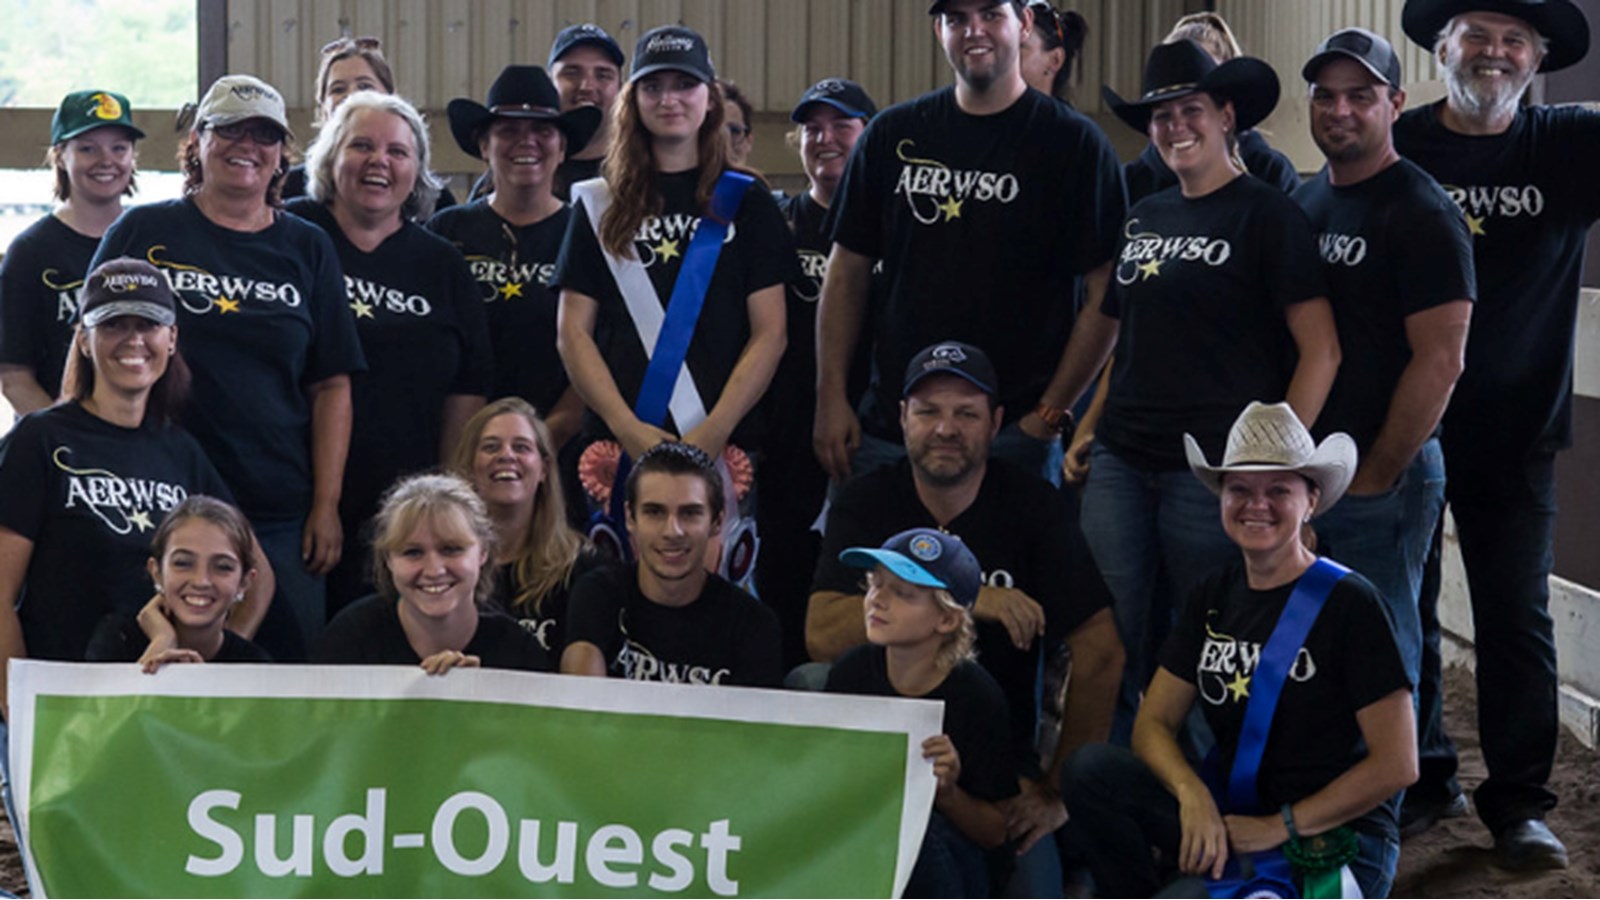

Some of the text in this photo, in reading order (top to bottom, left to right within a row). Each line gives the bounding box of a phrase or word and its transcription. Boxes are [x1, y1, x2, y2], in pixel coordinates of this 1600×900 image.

[895, 164, 1020, 203] AERWSO
[1120, 236, 1231, 266] AERWSO
[185, 789, 743, 898] Sud-Ouest
